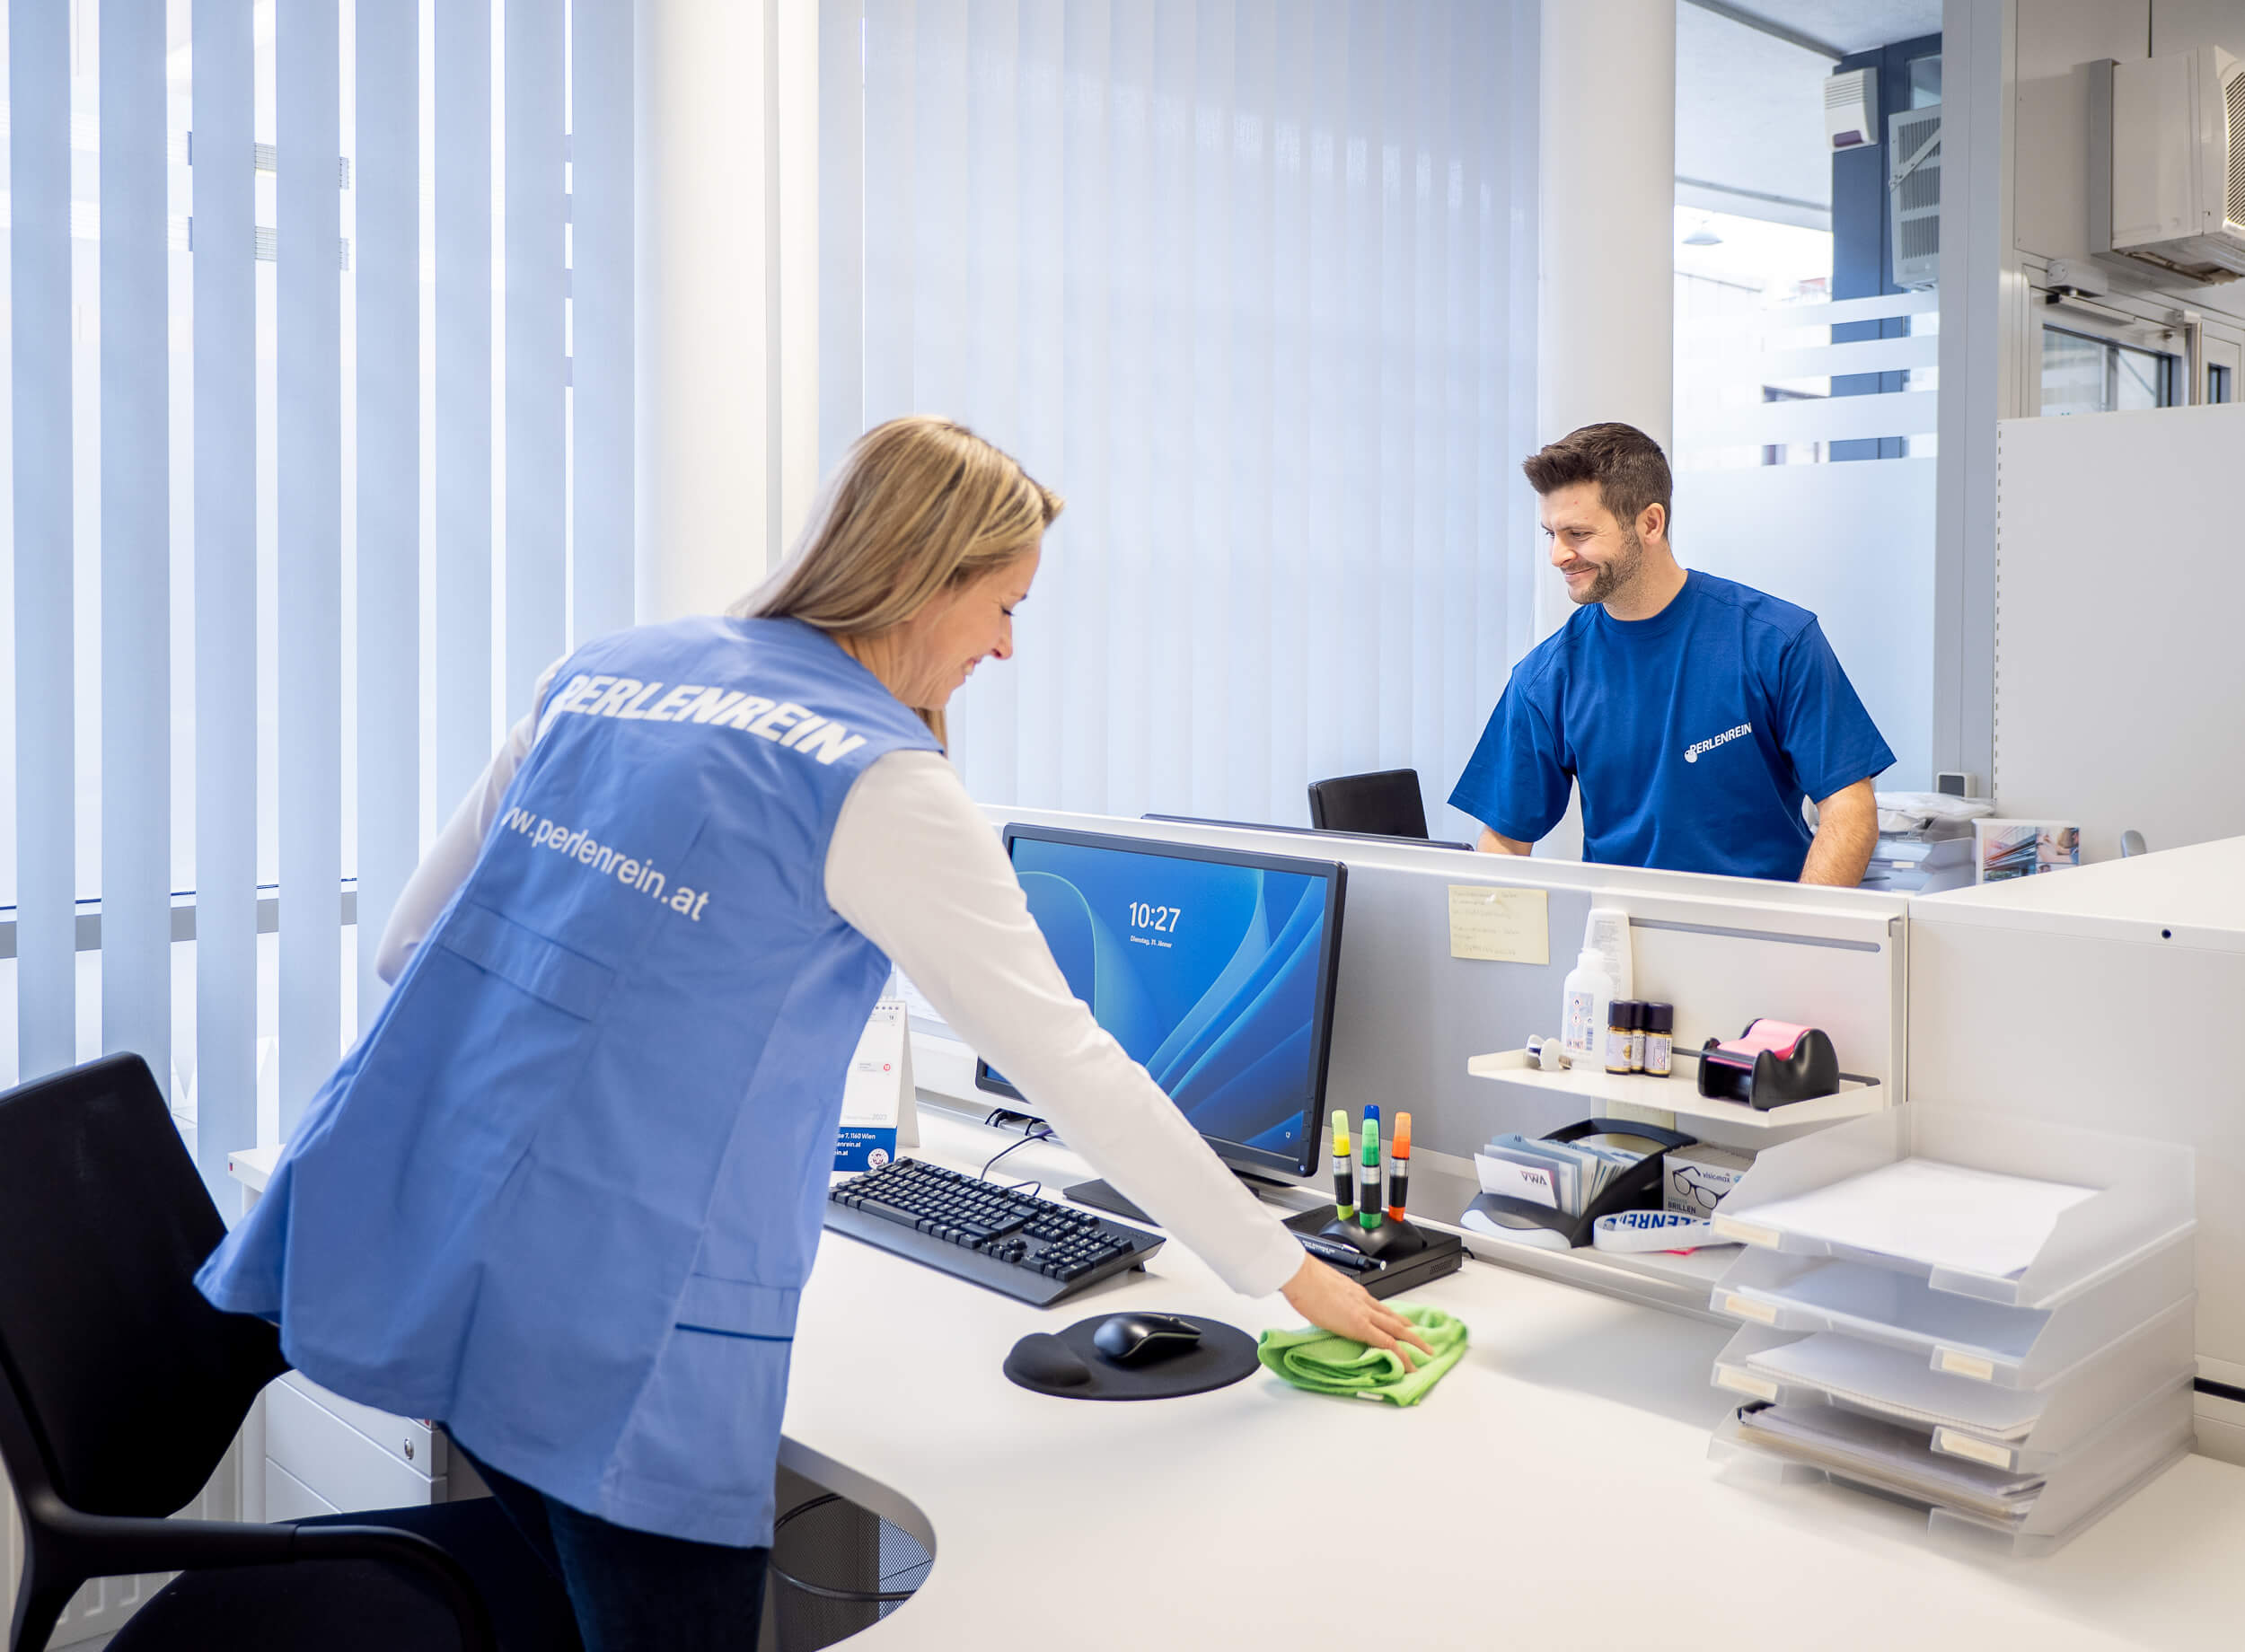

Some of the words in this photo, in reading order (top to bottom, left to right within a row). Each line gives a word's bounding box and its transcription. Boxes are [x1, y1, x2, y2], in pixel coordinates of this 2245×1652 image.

[546, 675, 867, 766] PERLENREIN
[1688, 722, 1752, 756] PERLENREIN
[1129, 901, 1181, 933] 10:27
[1668, 1200, 1696, 1215] BRILLEN
